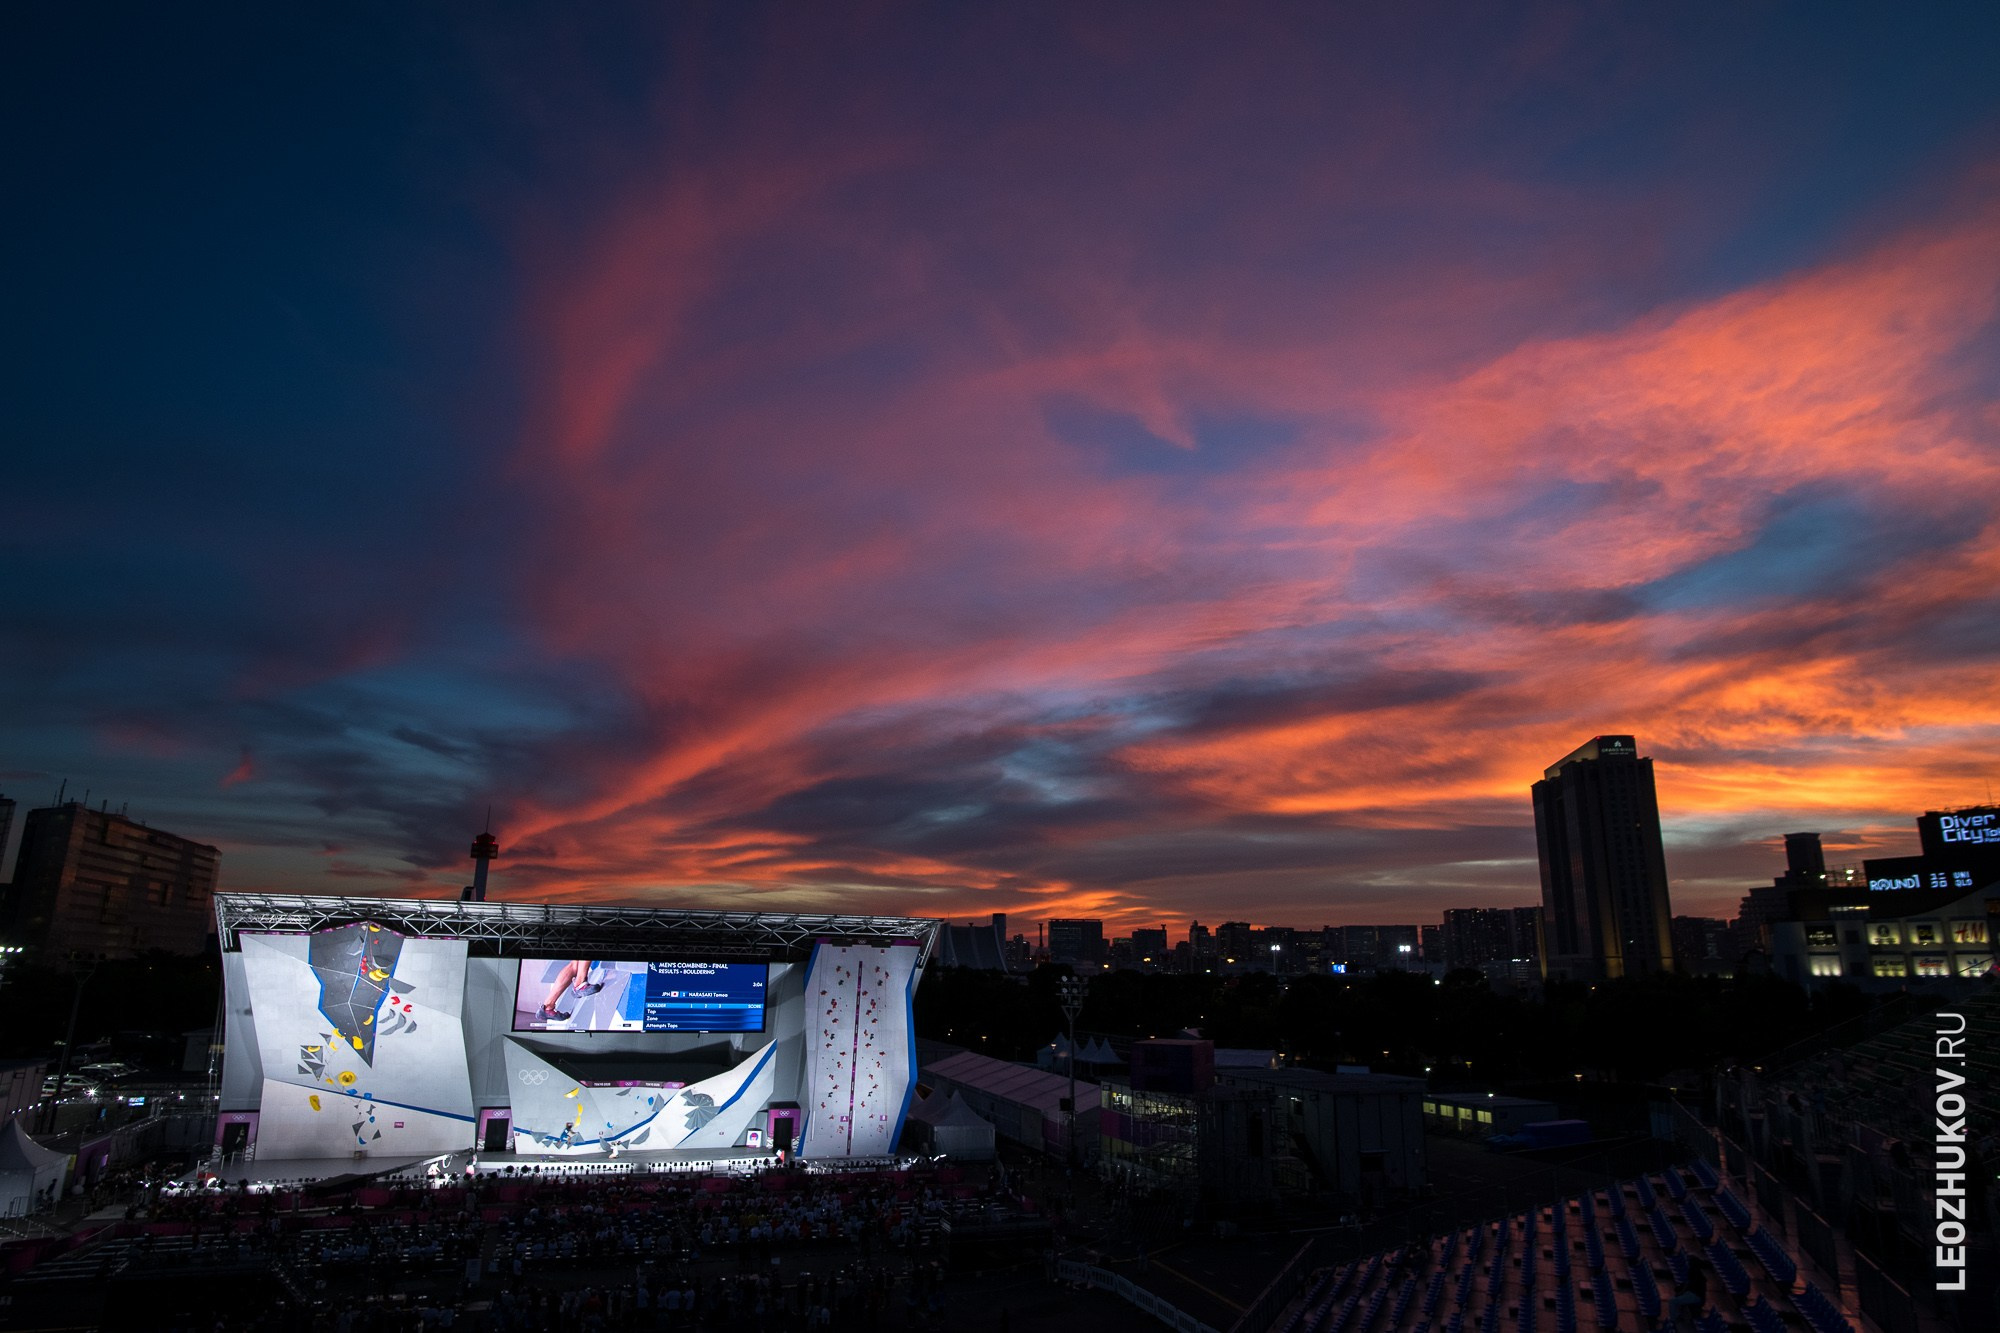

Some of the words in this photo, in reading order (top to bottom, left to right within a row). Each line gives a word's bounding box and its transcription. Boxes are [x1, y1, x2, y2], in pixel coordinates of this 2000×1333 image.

[1940, 814, 1995, 829] Diver
[1943, 828, 1983, 844] City
[1869, 874, 1920, 891] ROUND1
[1952, 871, 1970, 879] UNI
[1955, 922, 1984, 941] H&M
